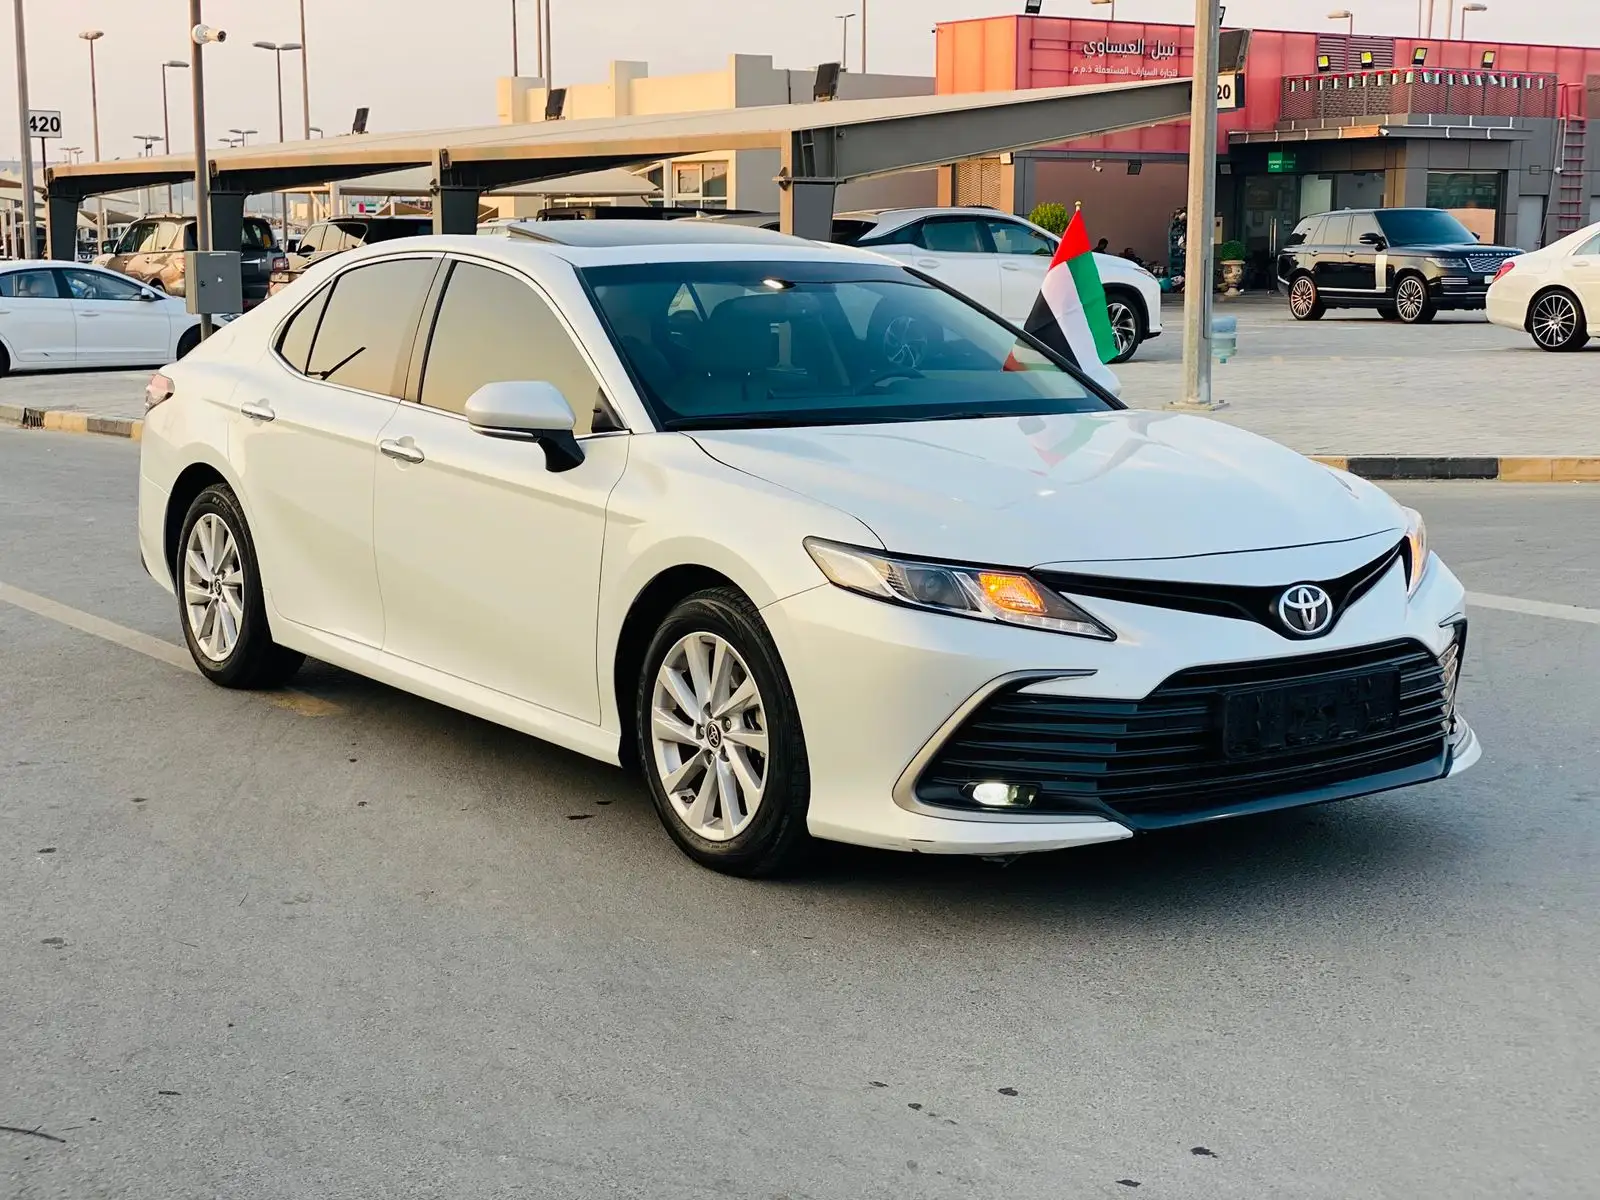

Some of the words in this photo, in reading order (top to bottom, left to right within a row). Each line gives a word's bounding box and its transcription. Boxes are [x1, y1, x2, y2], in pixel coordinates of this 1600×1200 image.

[1083, 37, 1145, 59] العيساوي
[1151, 39, 1175, 60] نبيل
[1094, 65, 1129, 75] المستعملة
[1131, 67, 1158, 77] السيارات
[30, 116, 60, 132] 420
